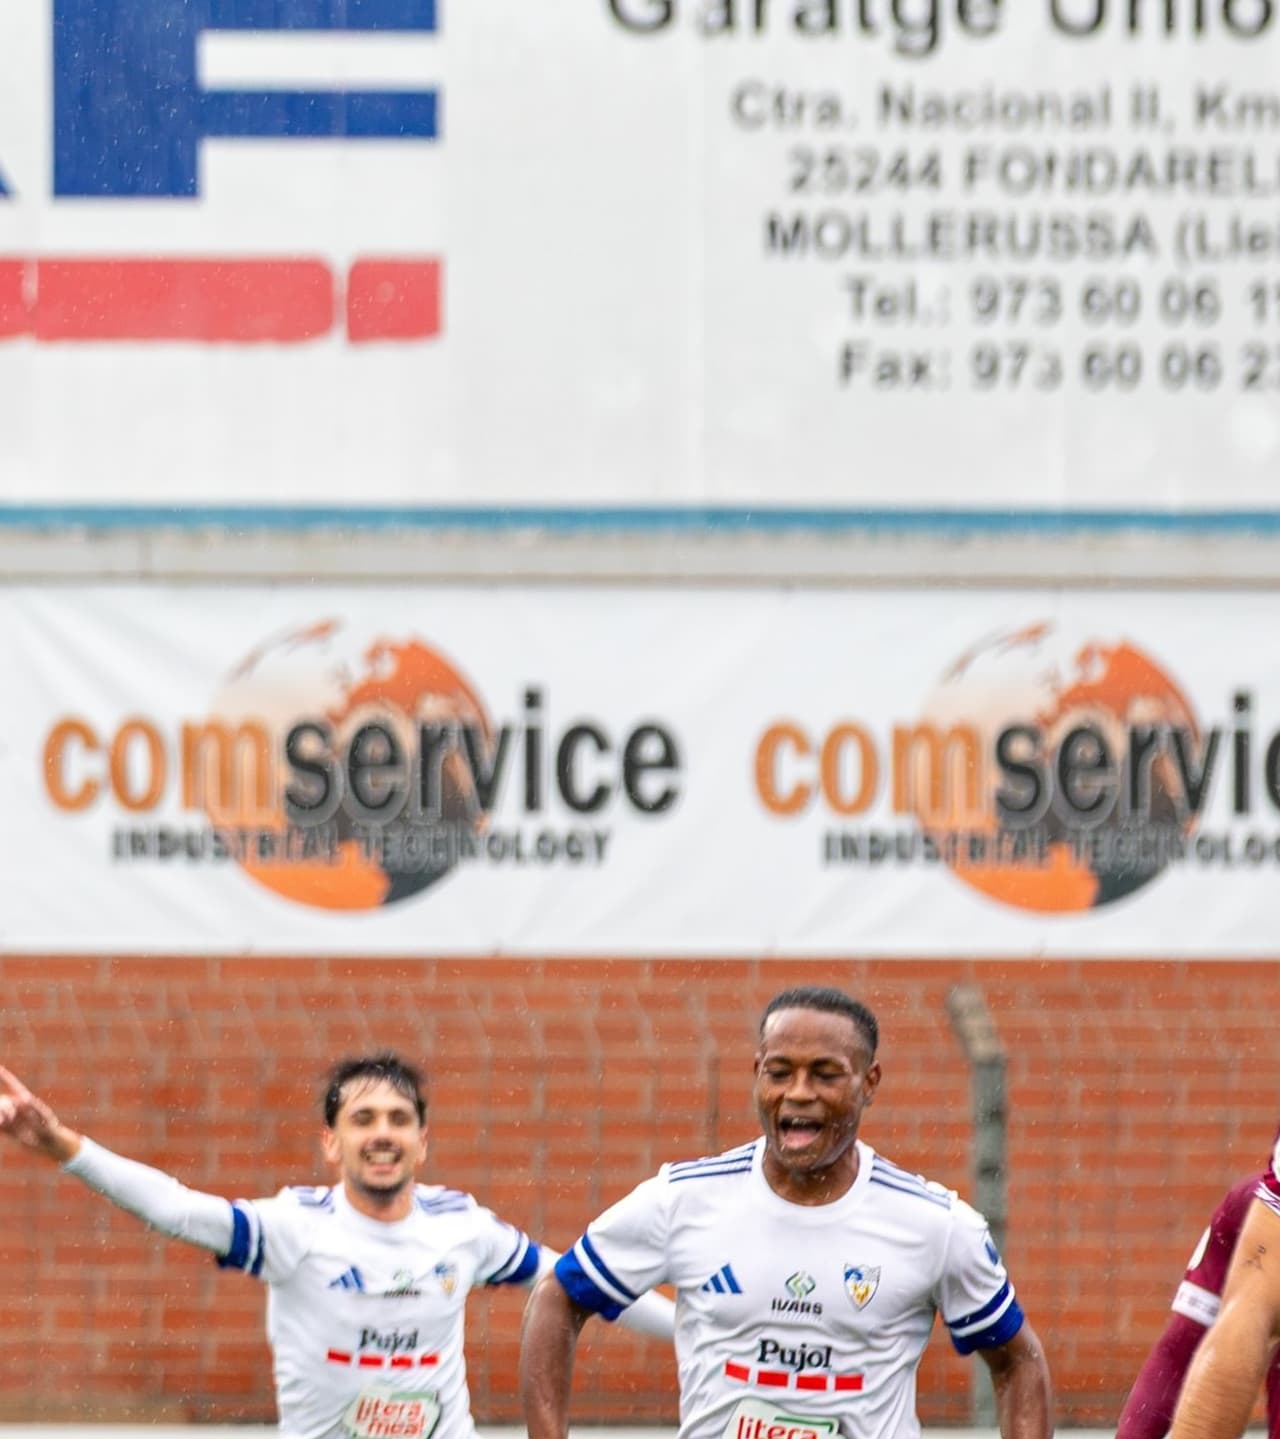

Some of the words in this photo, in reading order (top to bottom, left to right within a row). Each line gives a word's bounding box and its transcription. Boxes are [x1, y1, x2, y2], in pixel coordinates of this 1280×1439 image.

[876, 81, 1112, 131] Nacional
[961, 147, 1280, 196] FONDAREL
[763, 211, 1158, 261] MOLLERUSSA
[969, 276, 1064, 330] 973
[40, 690, 683, 820] comservice
[1070, 829, 1280, 867] TECHNOLO
[756, 1338, 833, 1373] Pujol
